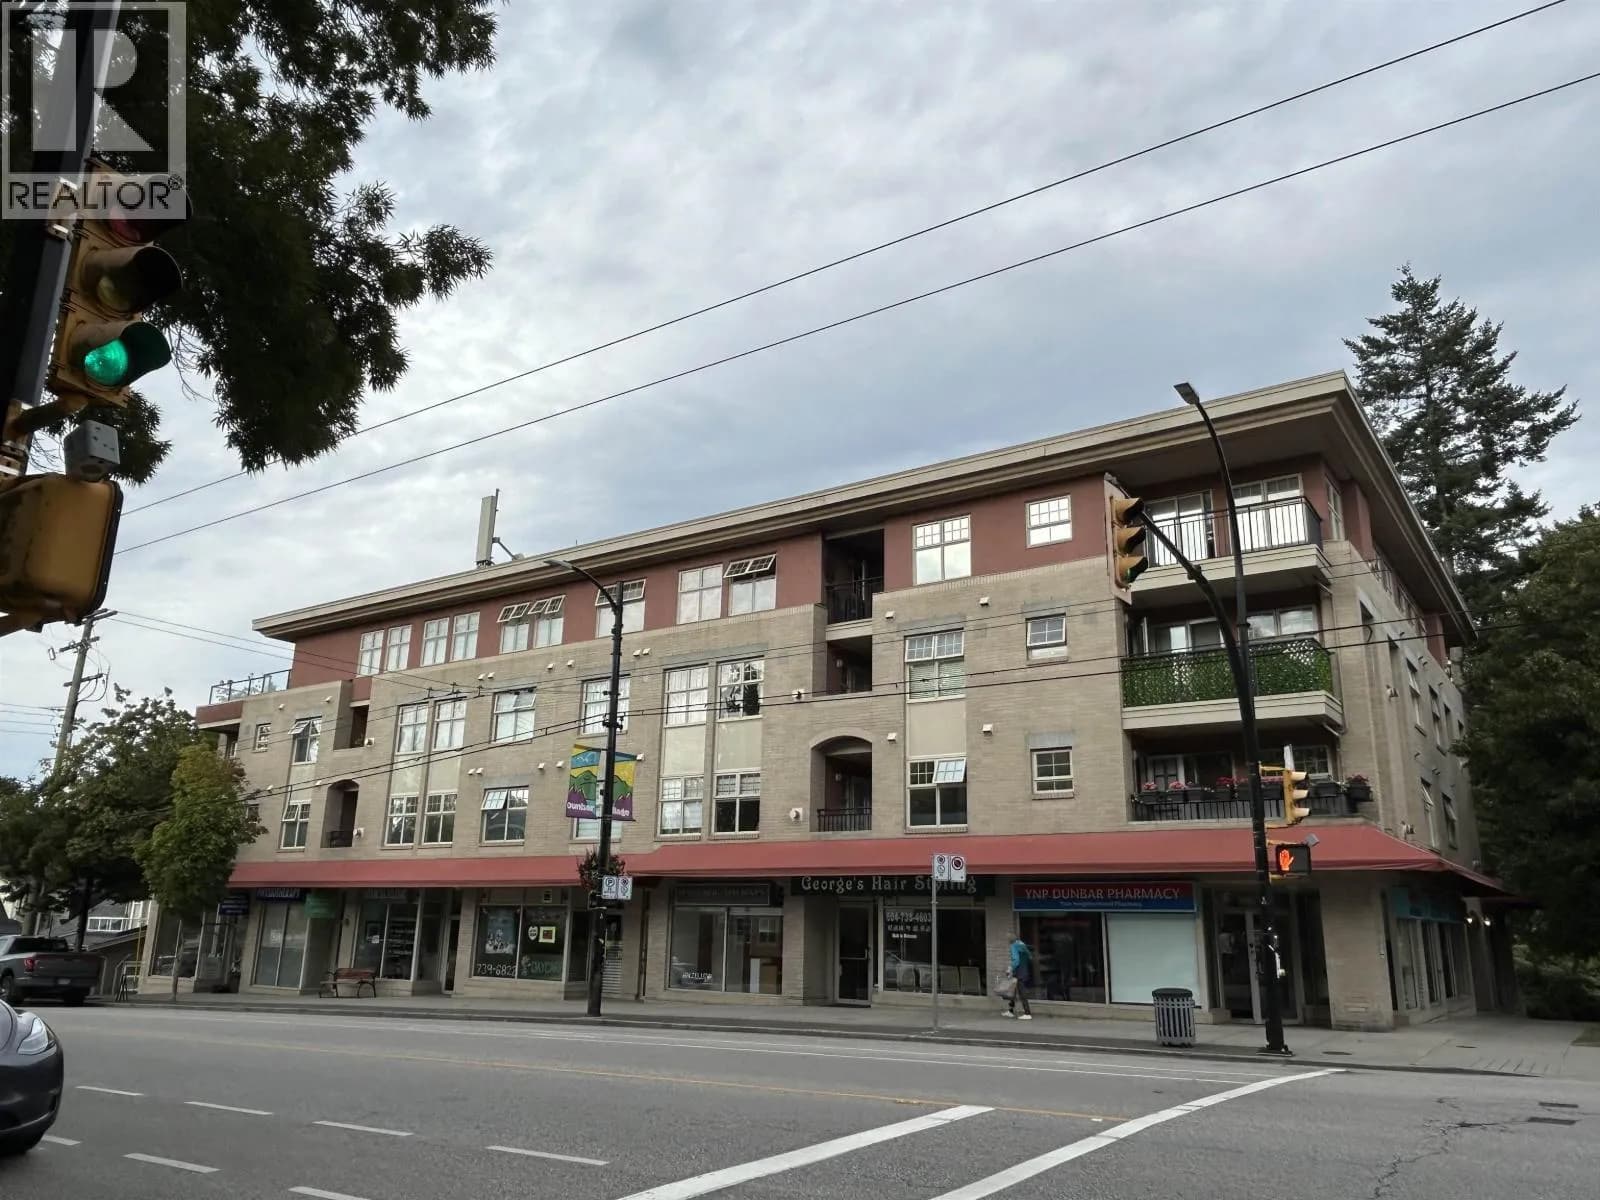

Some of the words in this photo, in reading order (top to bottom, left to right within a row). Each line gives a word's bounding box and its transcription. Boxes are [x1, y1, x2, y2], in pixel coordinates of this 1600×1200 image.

[801, 876, 864, 893] George's
[872, 877, 907, 891] Hair
[1052, 888, 1104, 899] DUNBAR
[1107, 887, 1180, 899] PHARMACY
